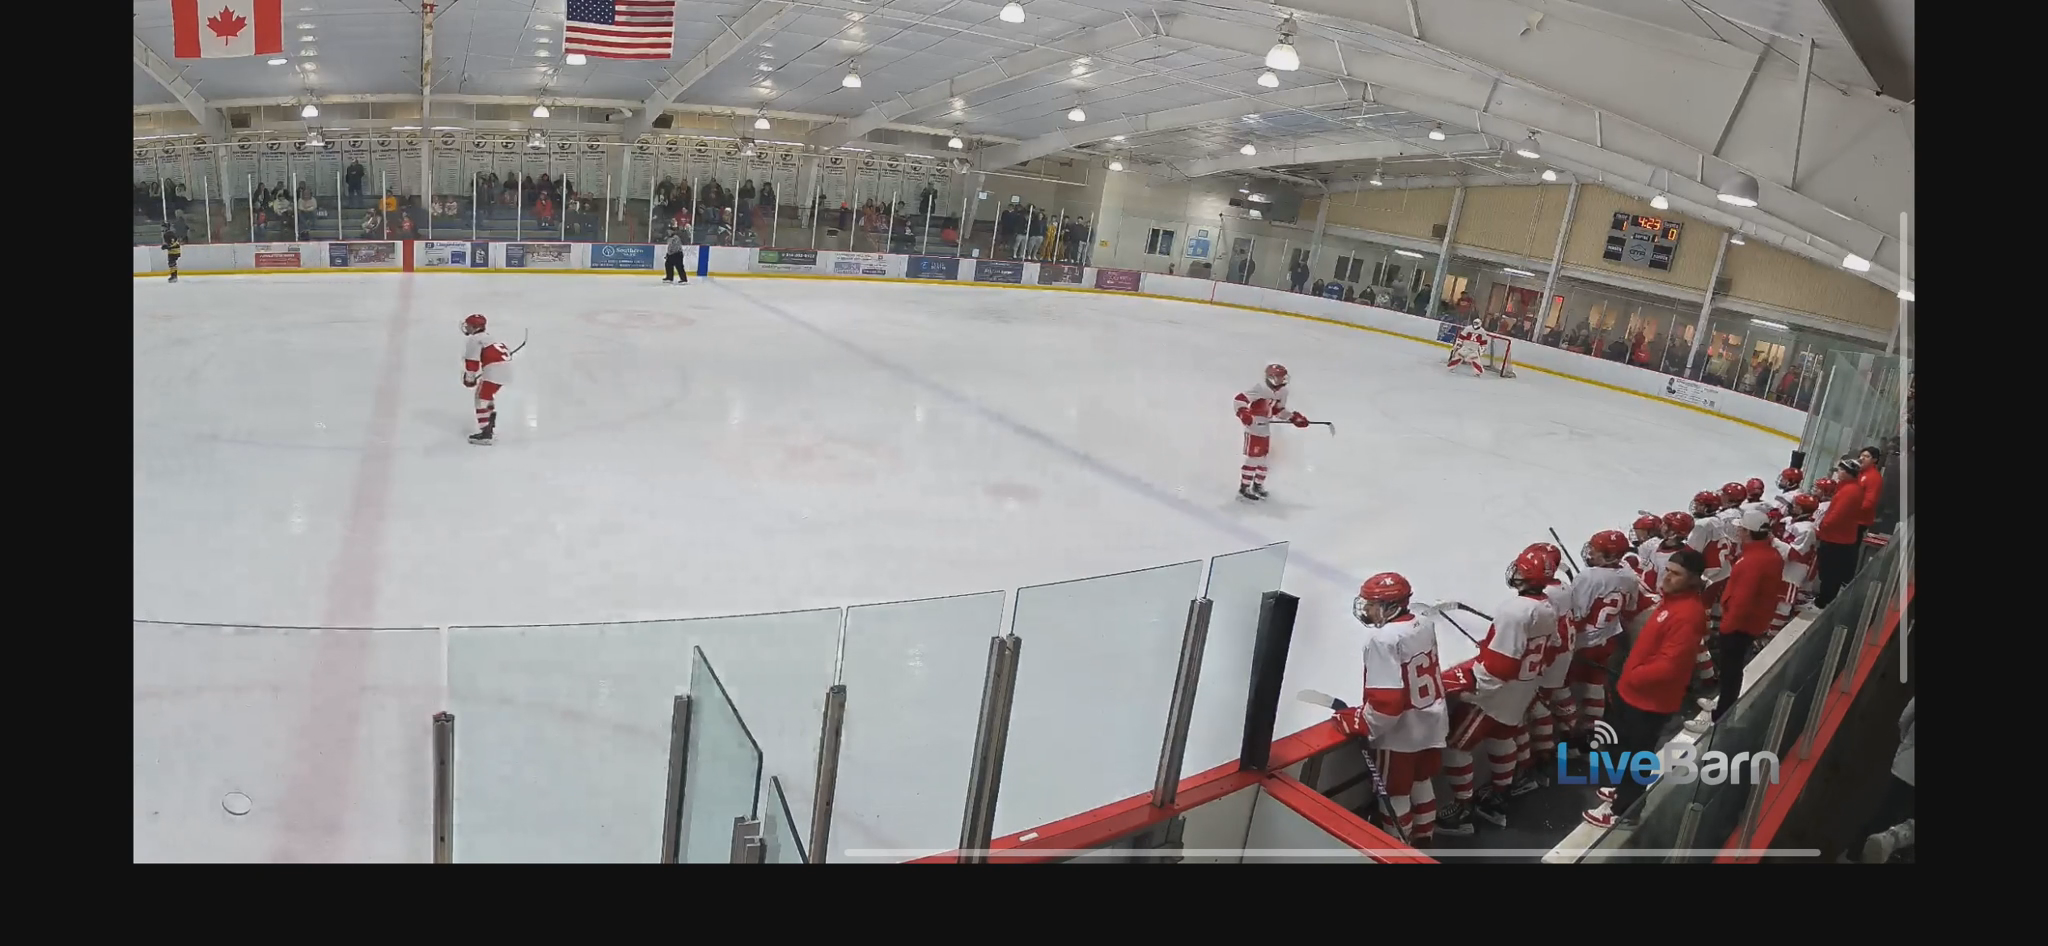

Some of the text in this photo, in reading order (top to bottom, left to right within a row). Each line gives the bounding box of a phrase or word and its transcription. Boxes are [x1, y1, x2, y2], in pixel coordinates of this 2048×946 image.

[1638, 216, 1662, 231] 4:23
[1668, 228, 1678, 240] 0
[1470, 333, 1479, 342] K
